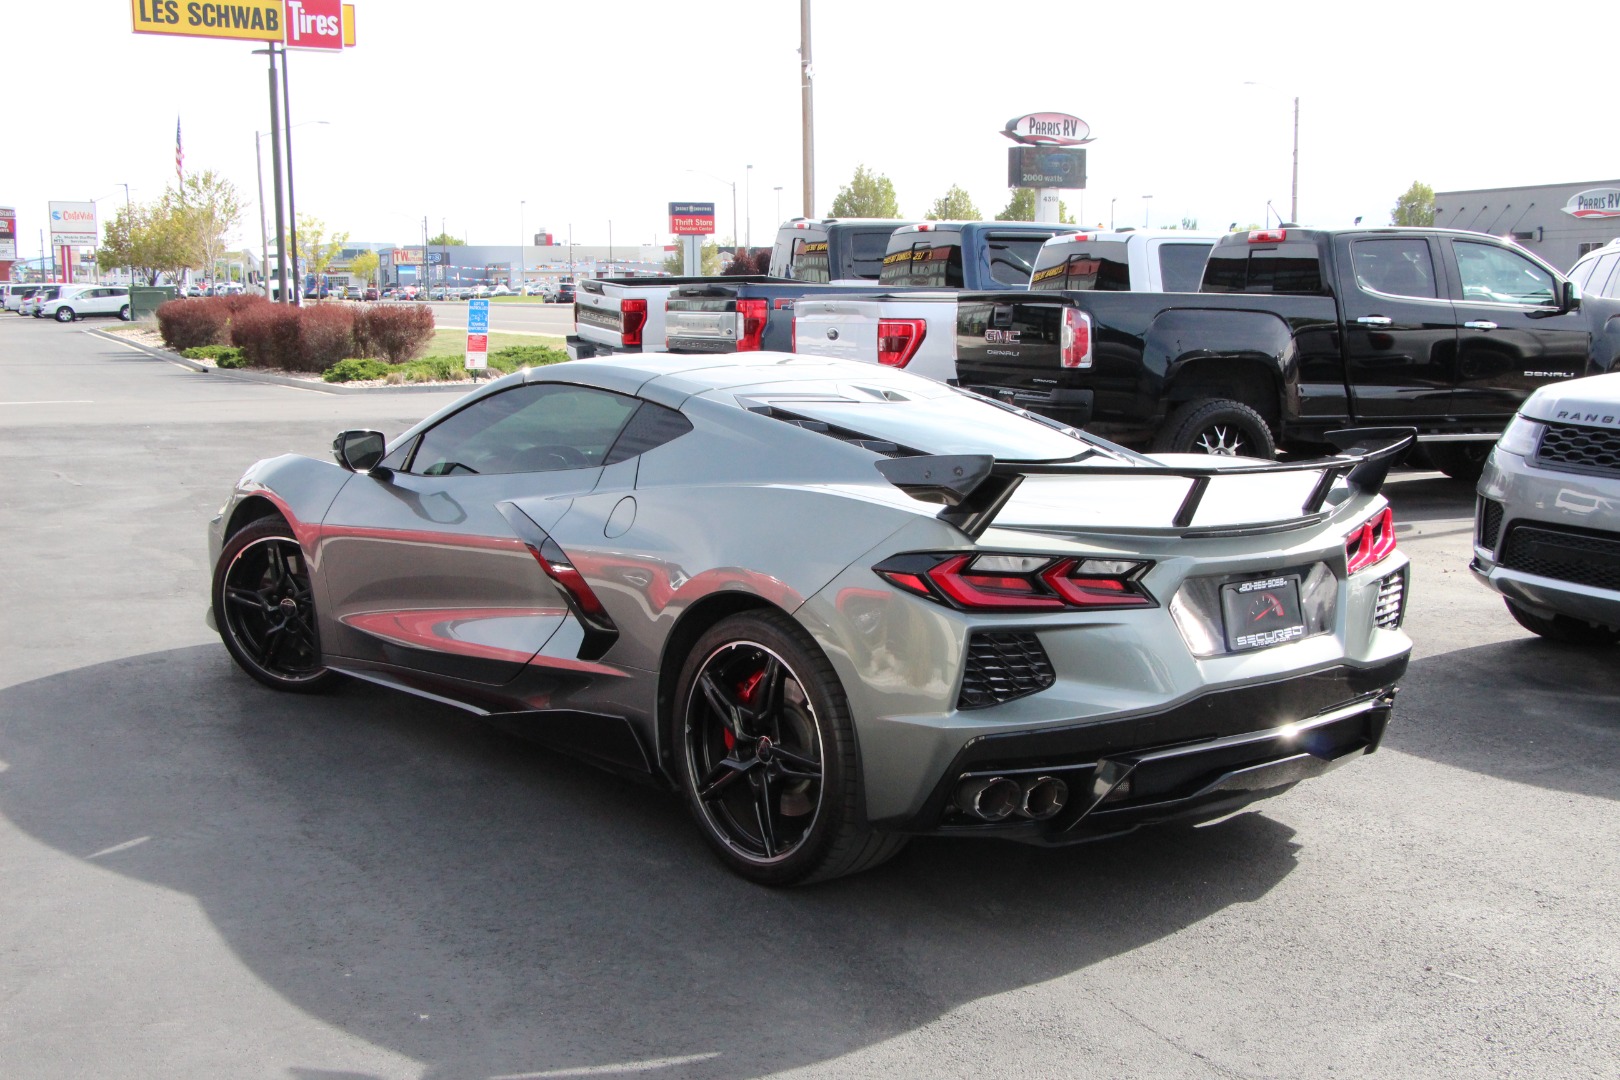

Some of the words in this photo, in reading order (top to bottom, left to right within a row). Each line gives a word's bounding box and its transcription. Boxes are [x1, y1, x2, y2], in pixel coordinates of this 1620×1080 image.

[140, 0, 179, 24] LES
[188, 2, 278, 31] SCHWAB
[288, 1, 338, 40] Tires
[1063, 119, 1078, 136] RV
[985, 329, 1021, 344] GMC
[1557, 411, 1620, 425] RANG
[1237, 626, 1304, 646] SECURED
